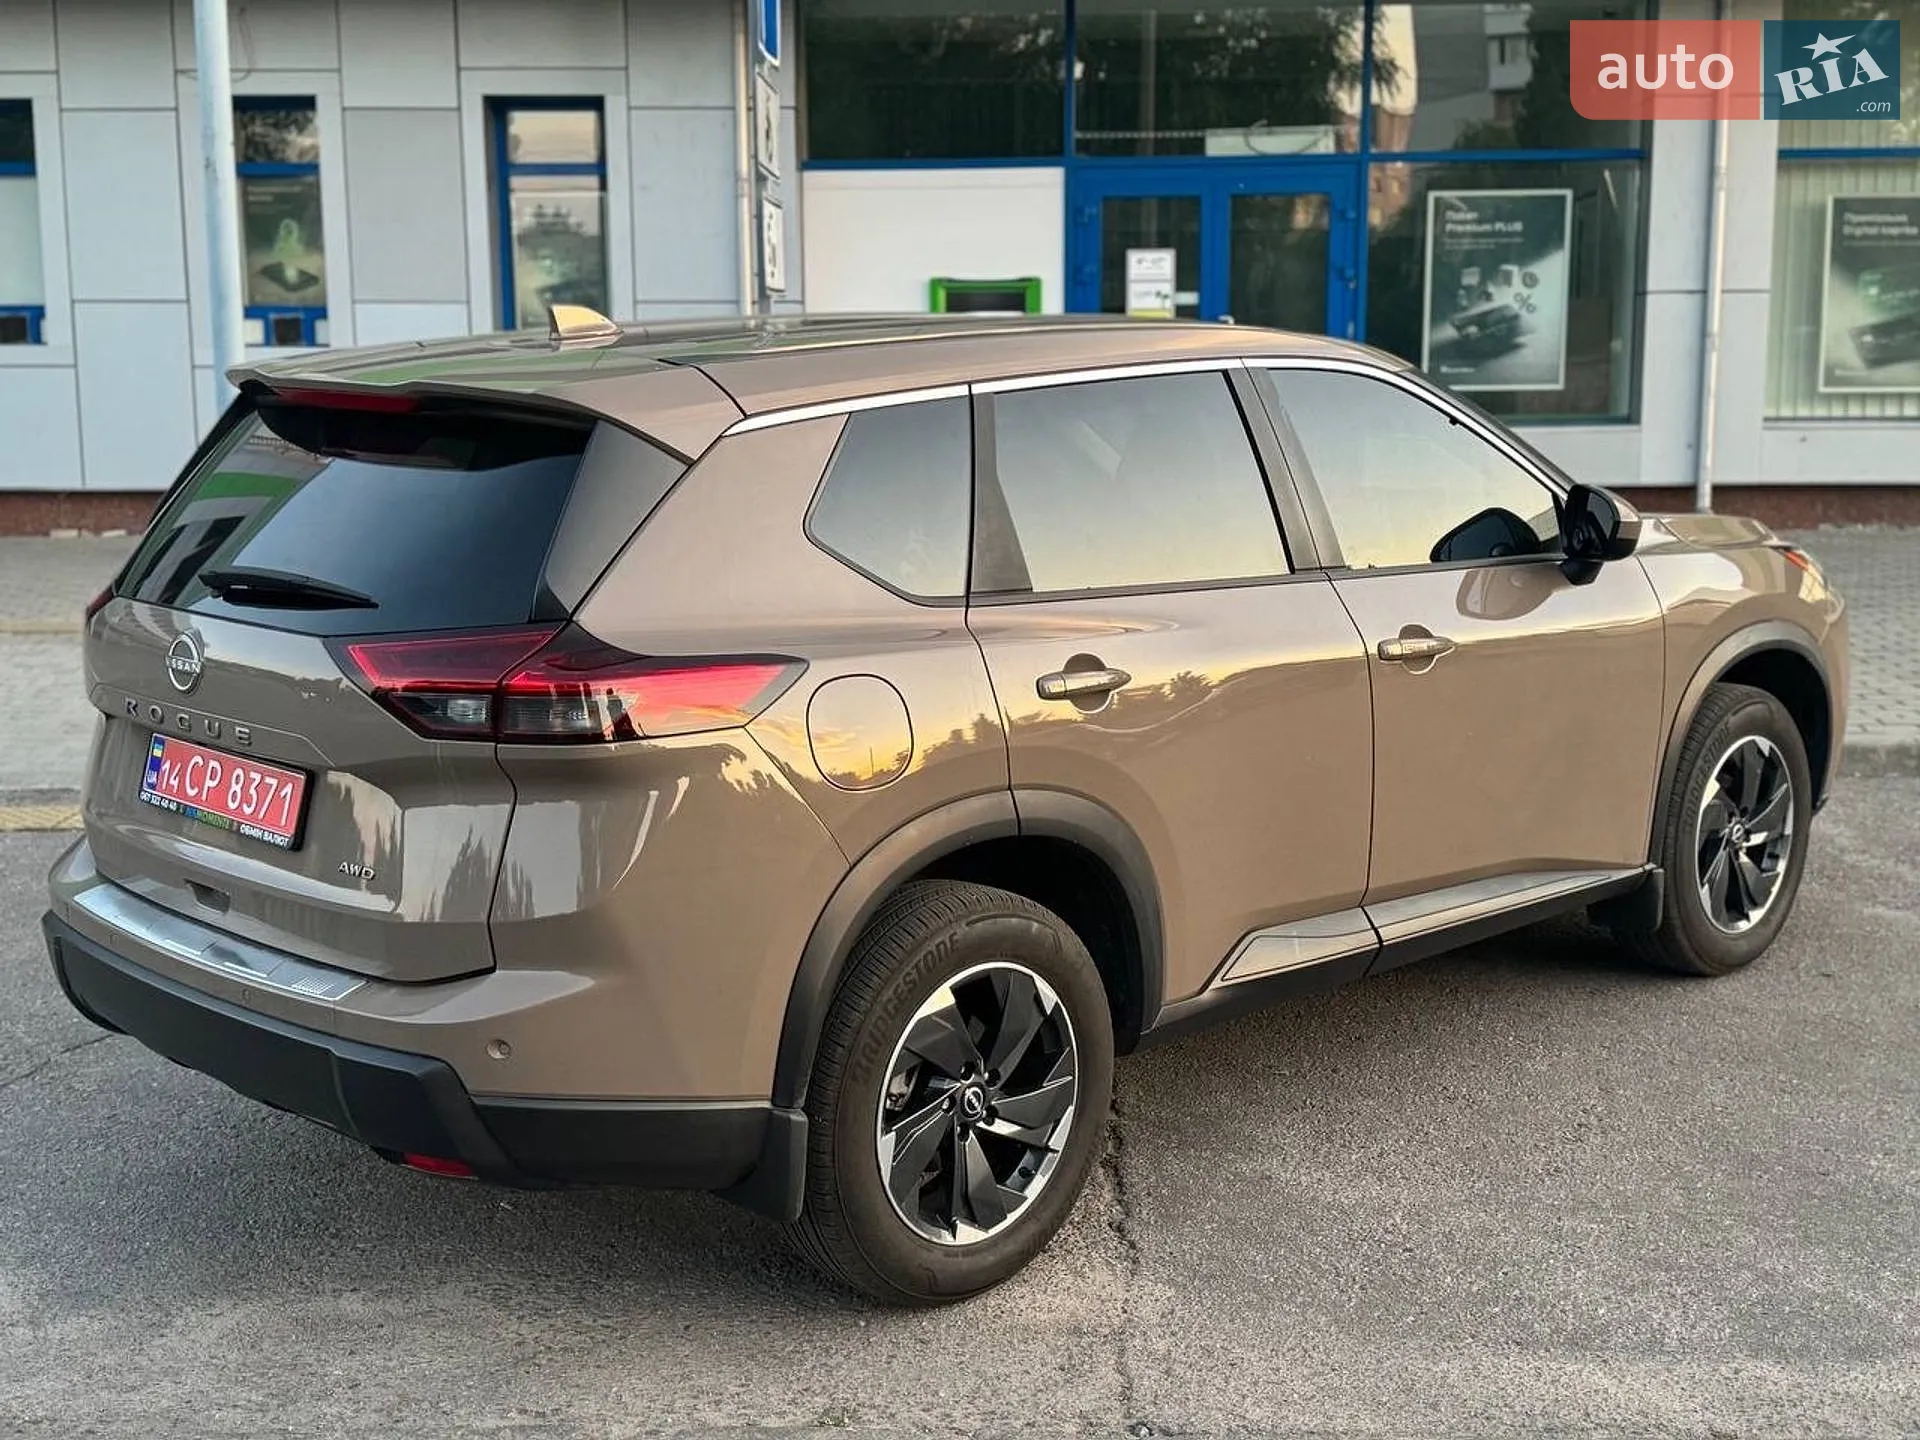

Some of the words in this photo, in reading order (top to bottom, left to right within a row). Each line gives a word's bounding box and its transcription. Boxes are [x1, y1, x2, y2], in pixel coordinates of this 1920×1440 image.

[124, 697, 251, 745] ROGUE
[227, 768, 294, 826] 8371
[337, 861, 375, 879] AWD
